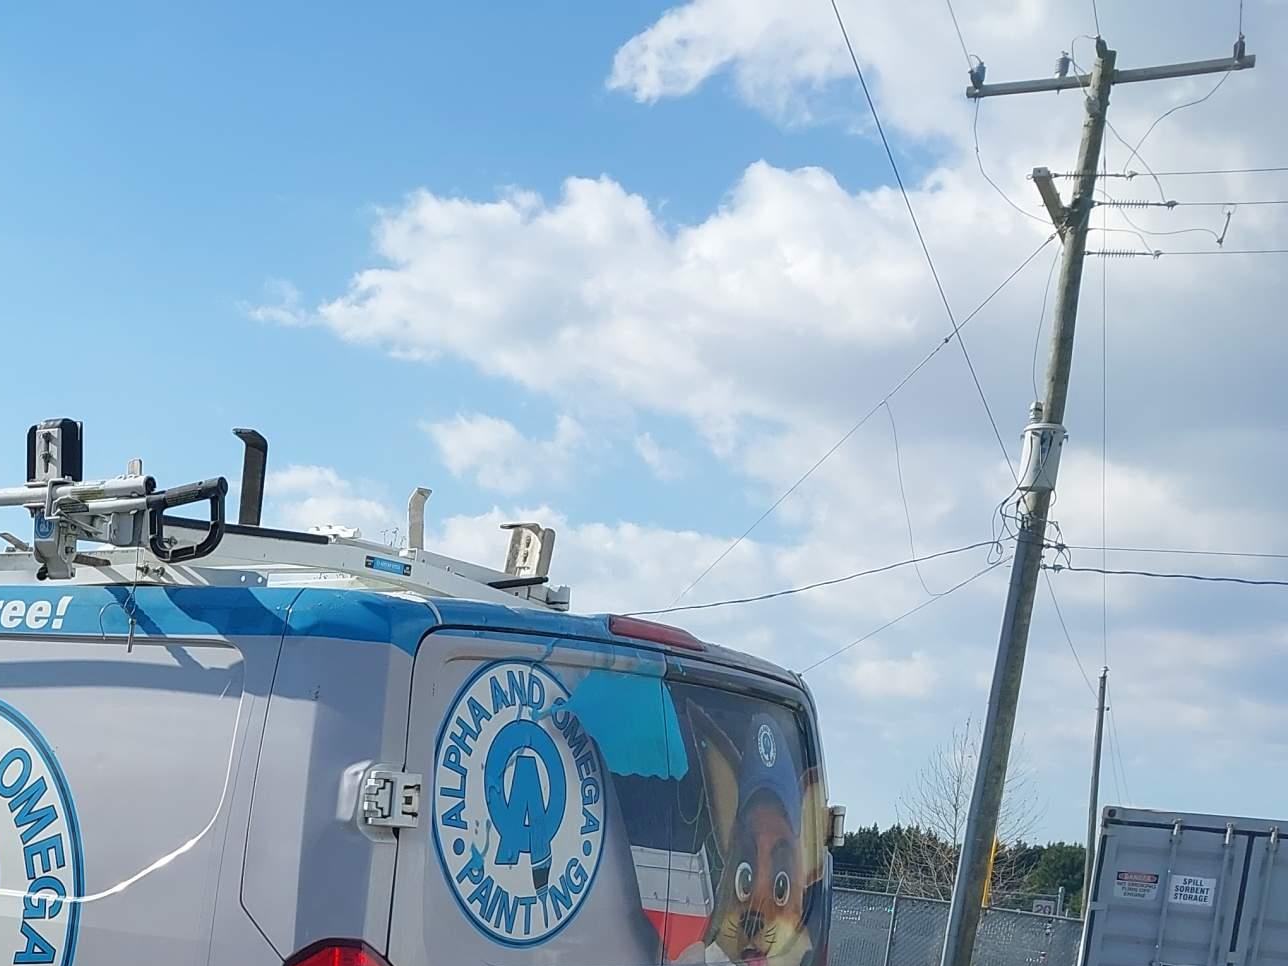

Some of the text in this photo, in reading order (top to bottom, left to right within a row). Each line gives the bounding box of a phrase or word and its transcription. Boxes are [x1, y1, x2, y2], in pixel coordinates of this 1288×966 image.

[440, 670, 600, 835] ALPHA AND OMEGA
[1183, 878, 1204, 887] SPILL
[1175, 885, 1210, 895] SORBENT
[457, 856, 588, 935] PAINTING
[1174, 893, 1209, 903] STORAGE
